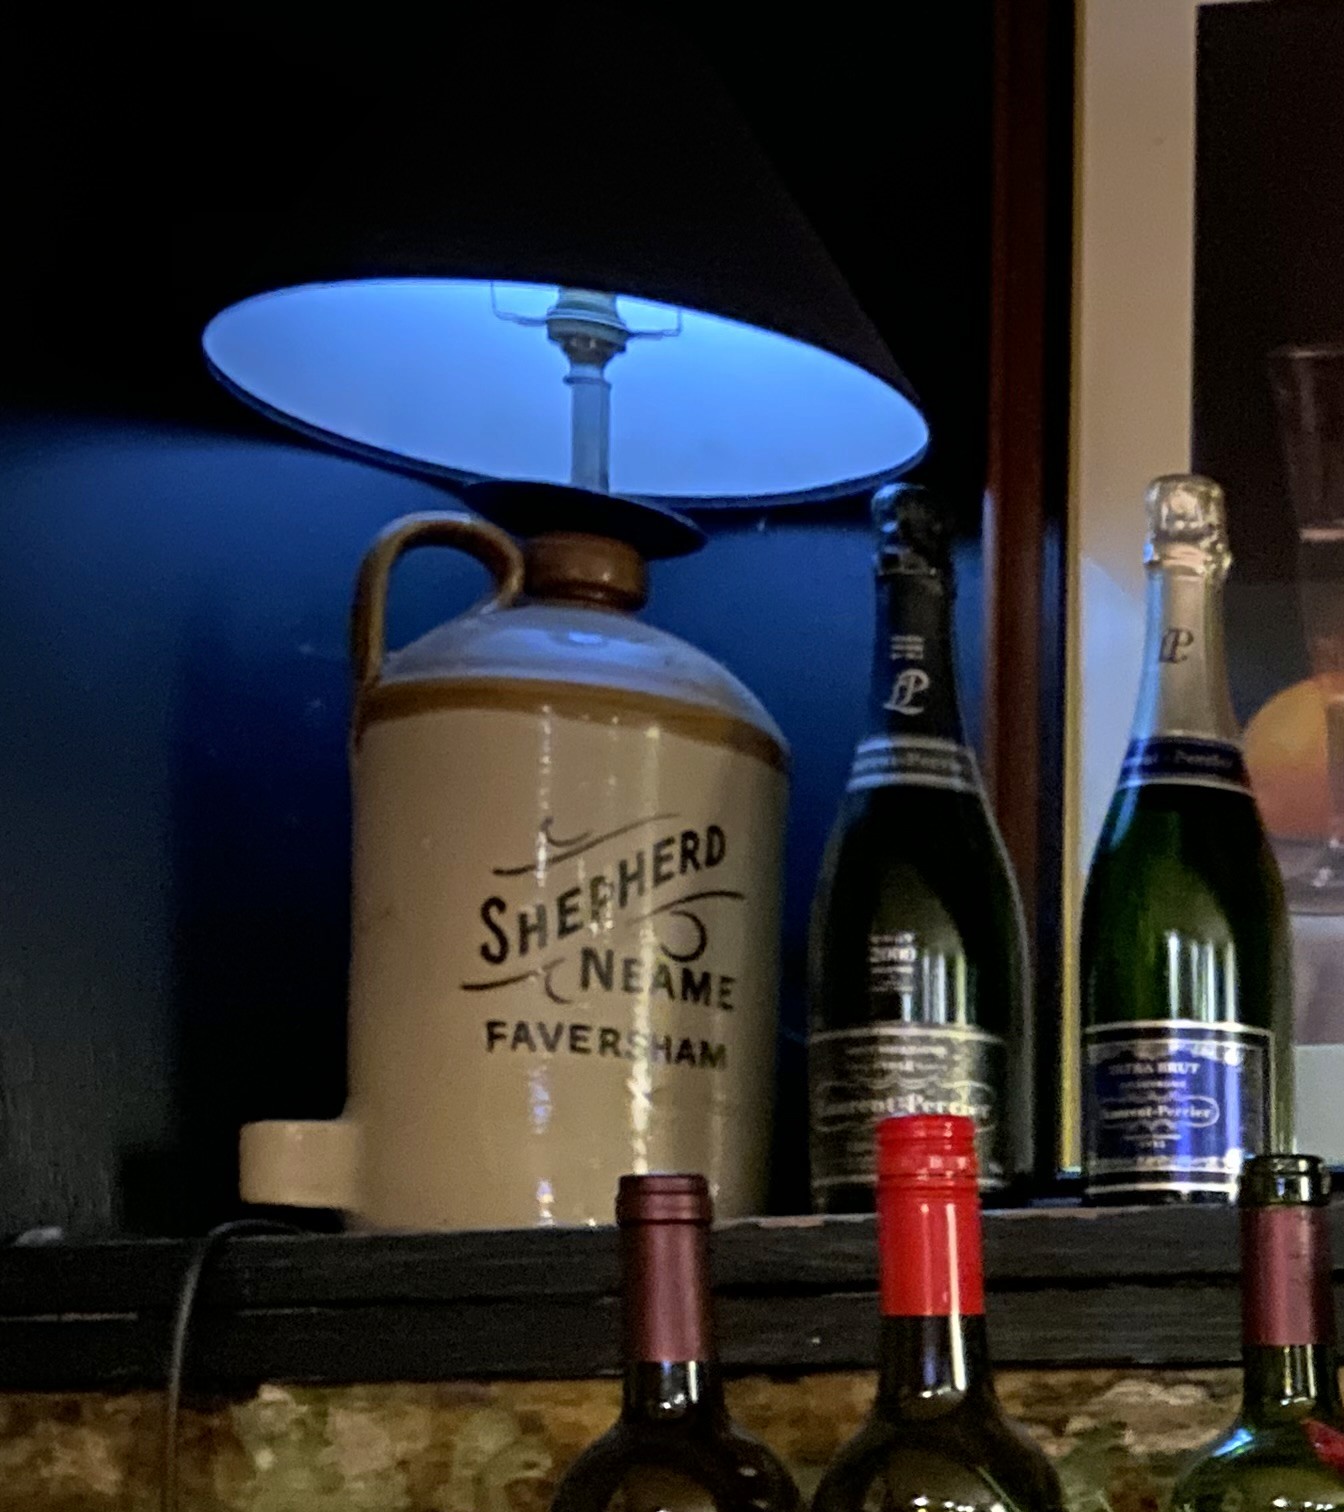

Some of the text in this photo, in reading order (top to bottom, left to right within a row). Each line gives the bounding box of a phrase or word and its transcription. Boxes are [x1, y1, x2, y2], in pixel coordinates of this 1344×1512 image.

[481, 825, 726, 964] SHEPHERD
[581, 946, 735, 1010] NEAME
[486, 1020, 728, 1068] FAVERSHAM
[1157, 1063, 1201, 1075] BRUT
